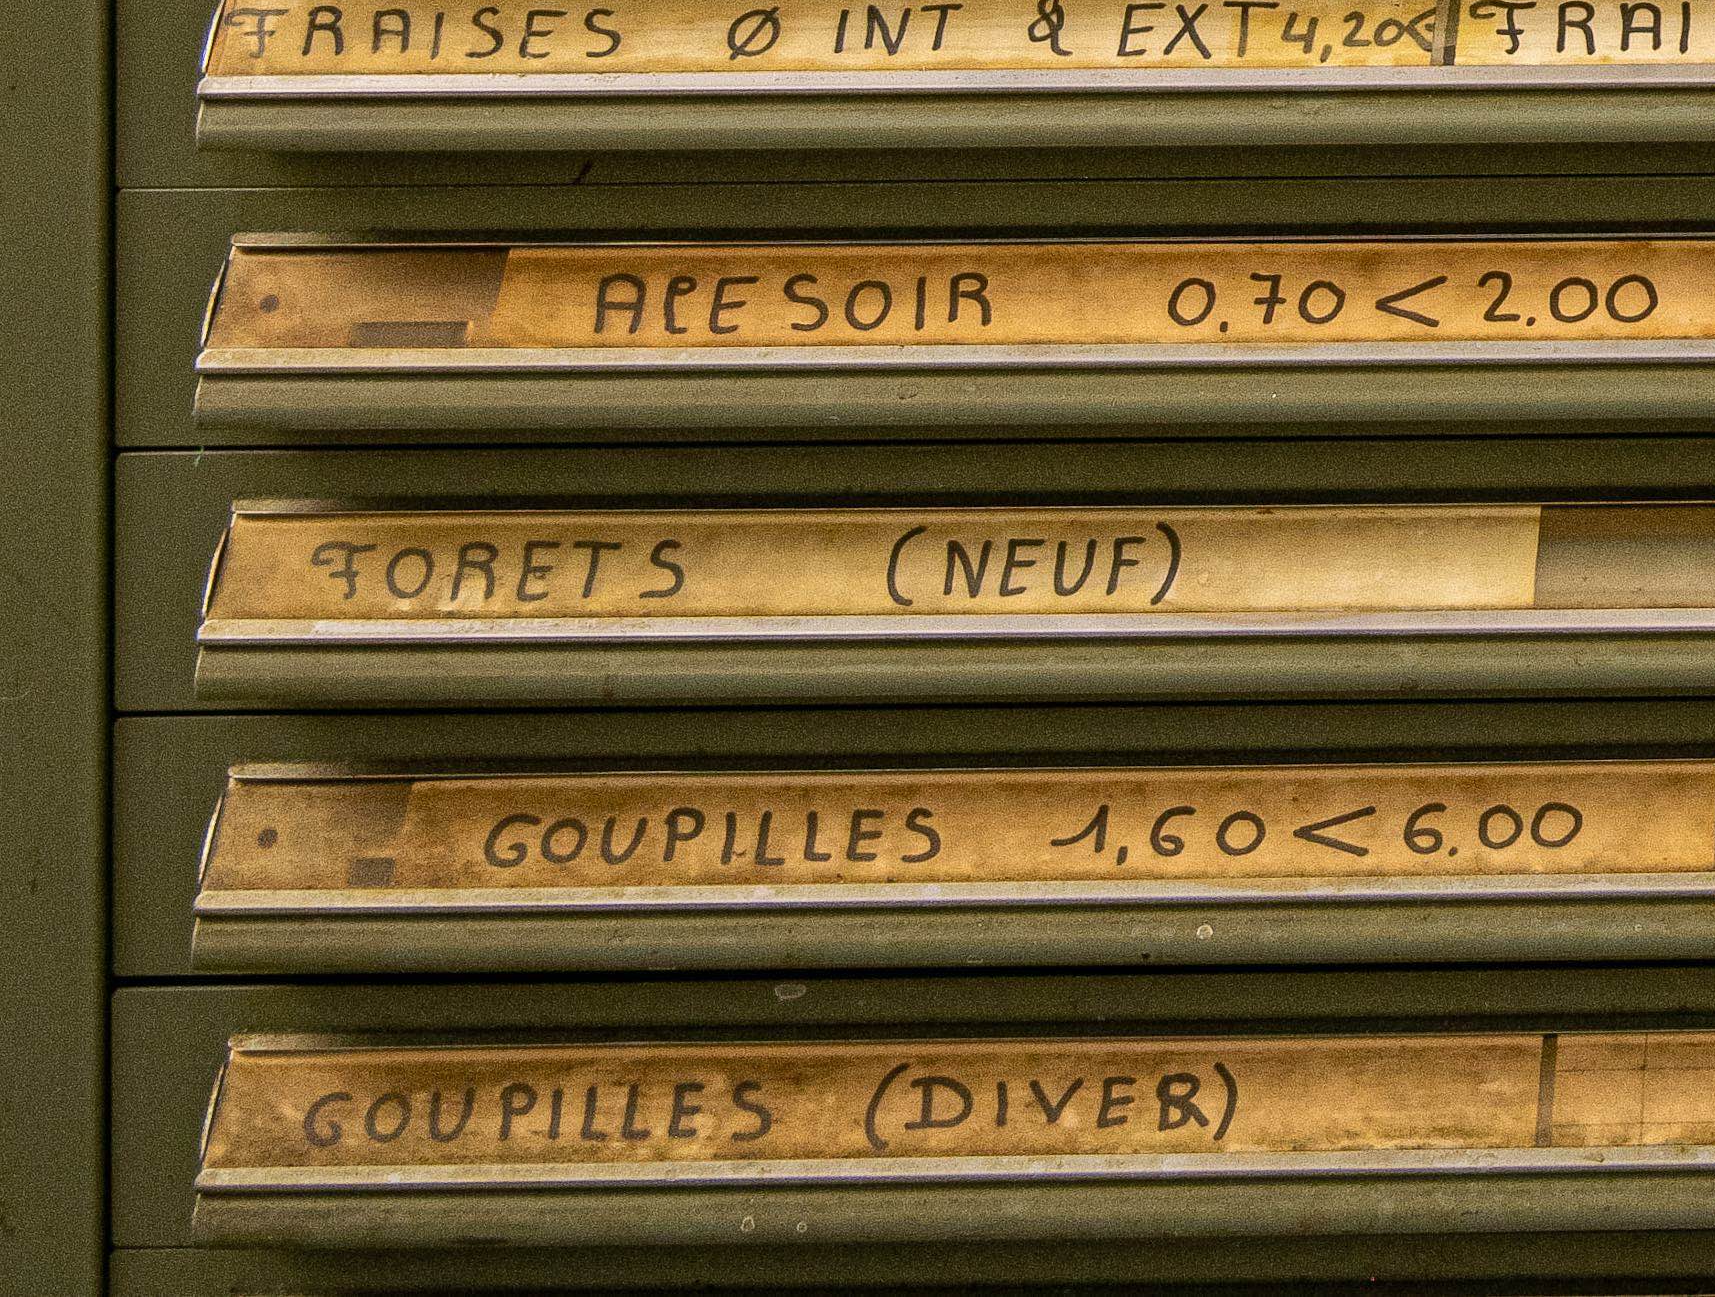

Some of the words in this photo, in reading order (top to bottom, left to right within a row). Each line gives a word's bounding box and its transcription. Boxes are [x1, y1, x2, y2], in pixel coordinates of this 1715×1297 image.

[226, 4, 624, 60] FRAISES
[834, 2, 963, 56] INT
[1116, 1, 1281, 60] EXT
[310, 539, 688, 603] FORETS
[484, 806, 942, 868] GOUPILLES
[302, 1080, 774, 1146] GOUPILLES
